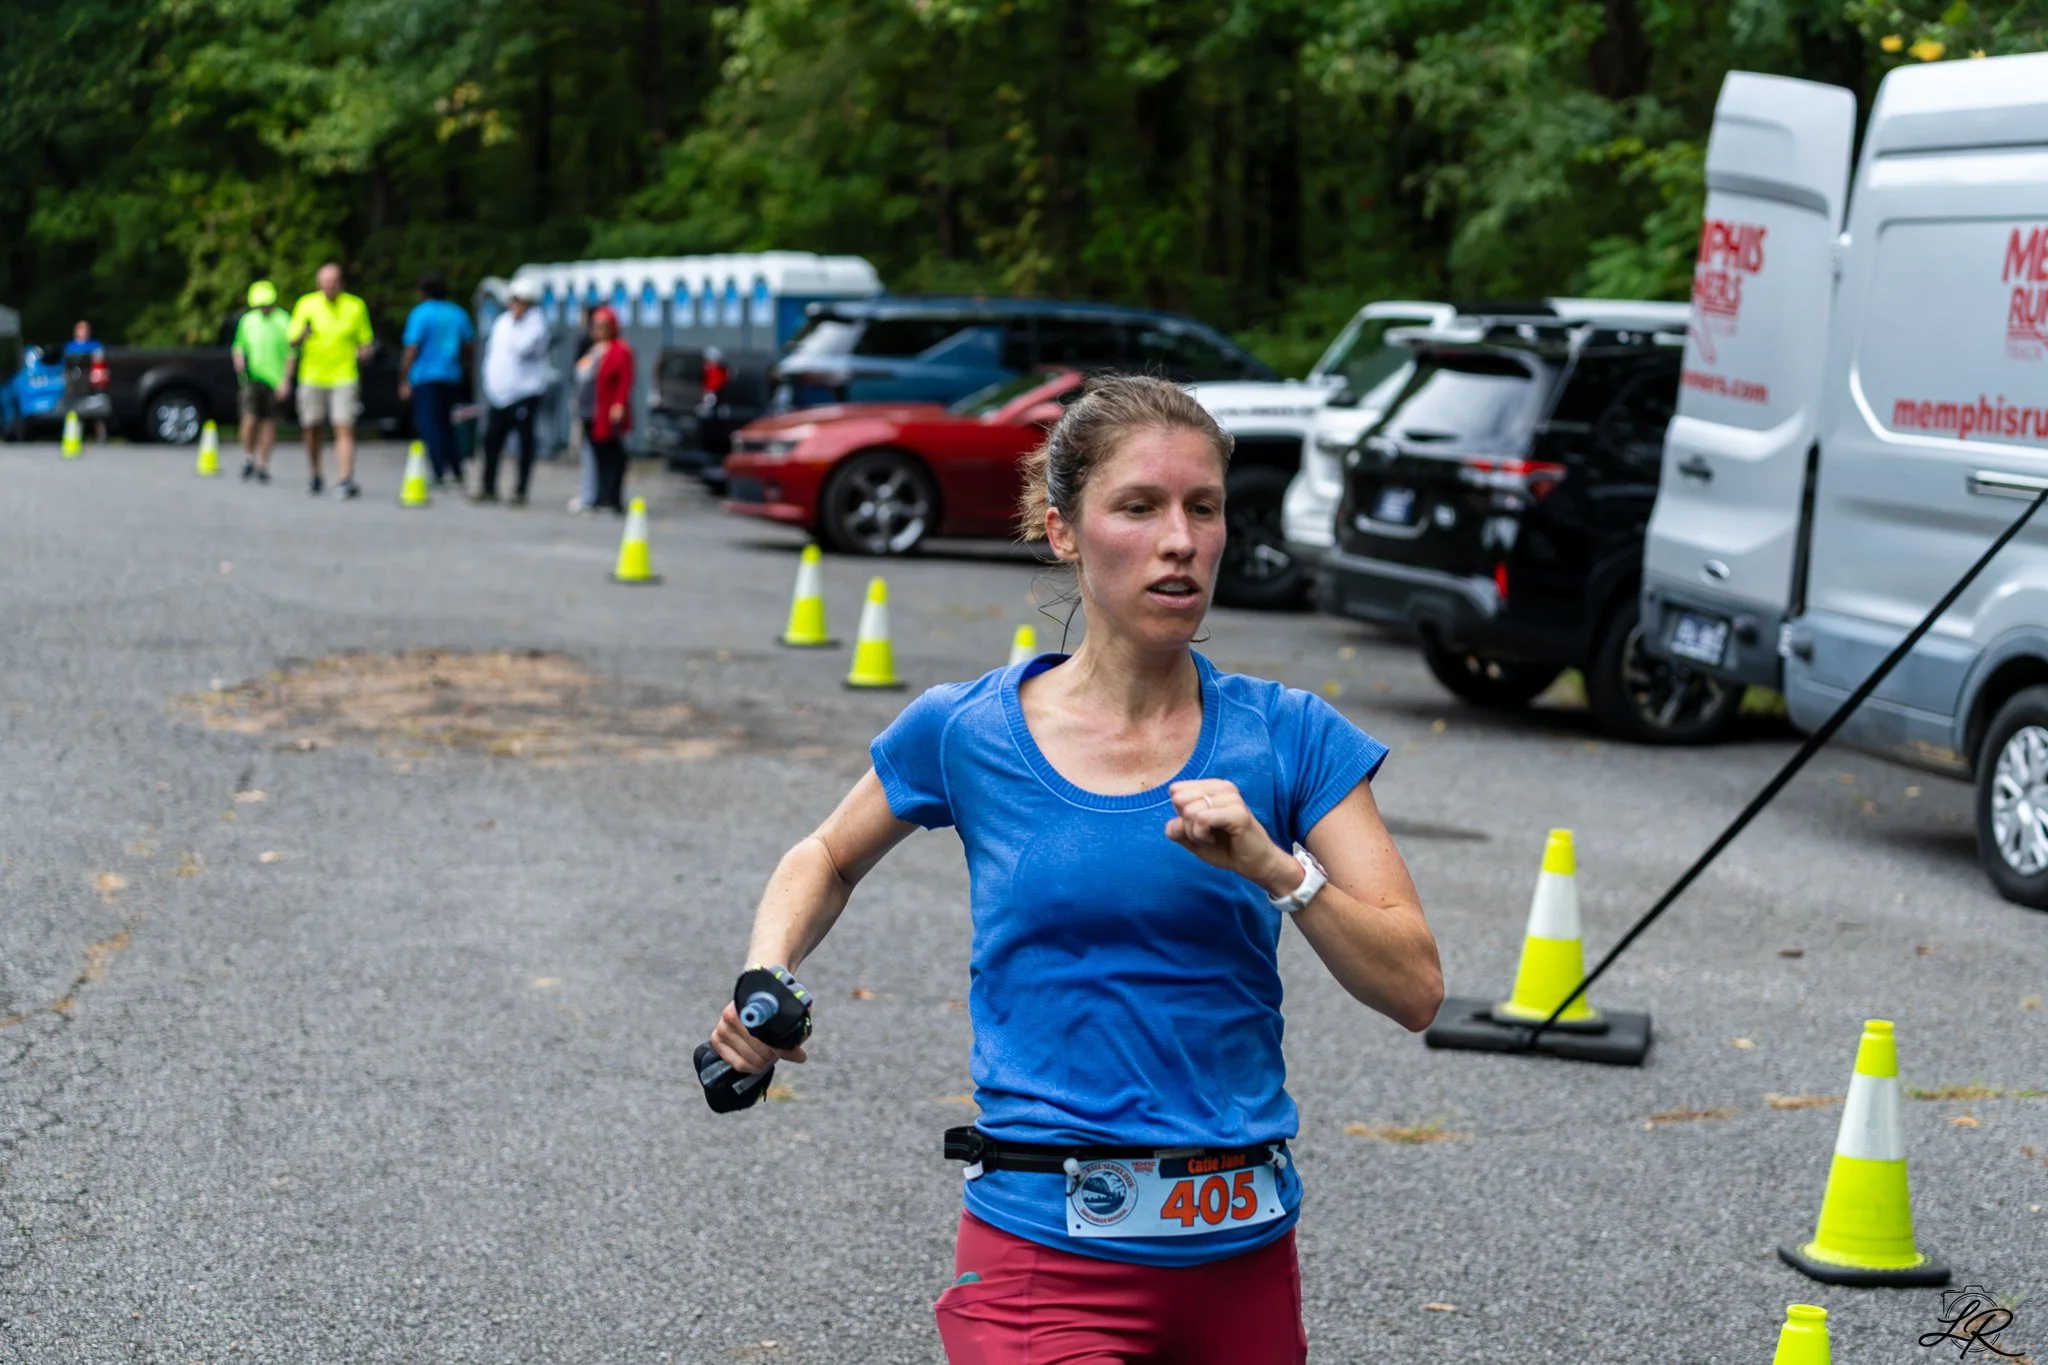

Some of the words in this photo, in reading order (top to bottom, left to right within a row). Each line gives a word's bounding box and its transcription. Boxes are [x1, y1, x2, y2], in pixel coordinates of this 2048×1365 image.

[1187, 1155, 1220, 1174] Catie
[1221, 1153, 1246, 1170] Jane
[1160, 1170, 1258, 1227] 405
